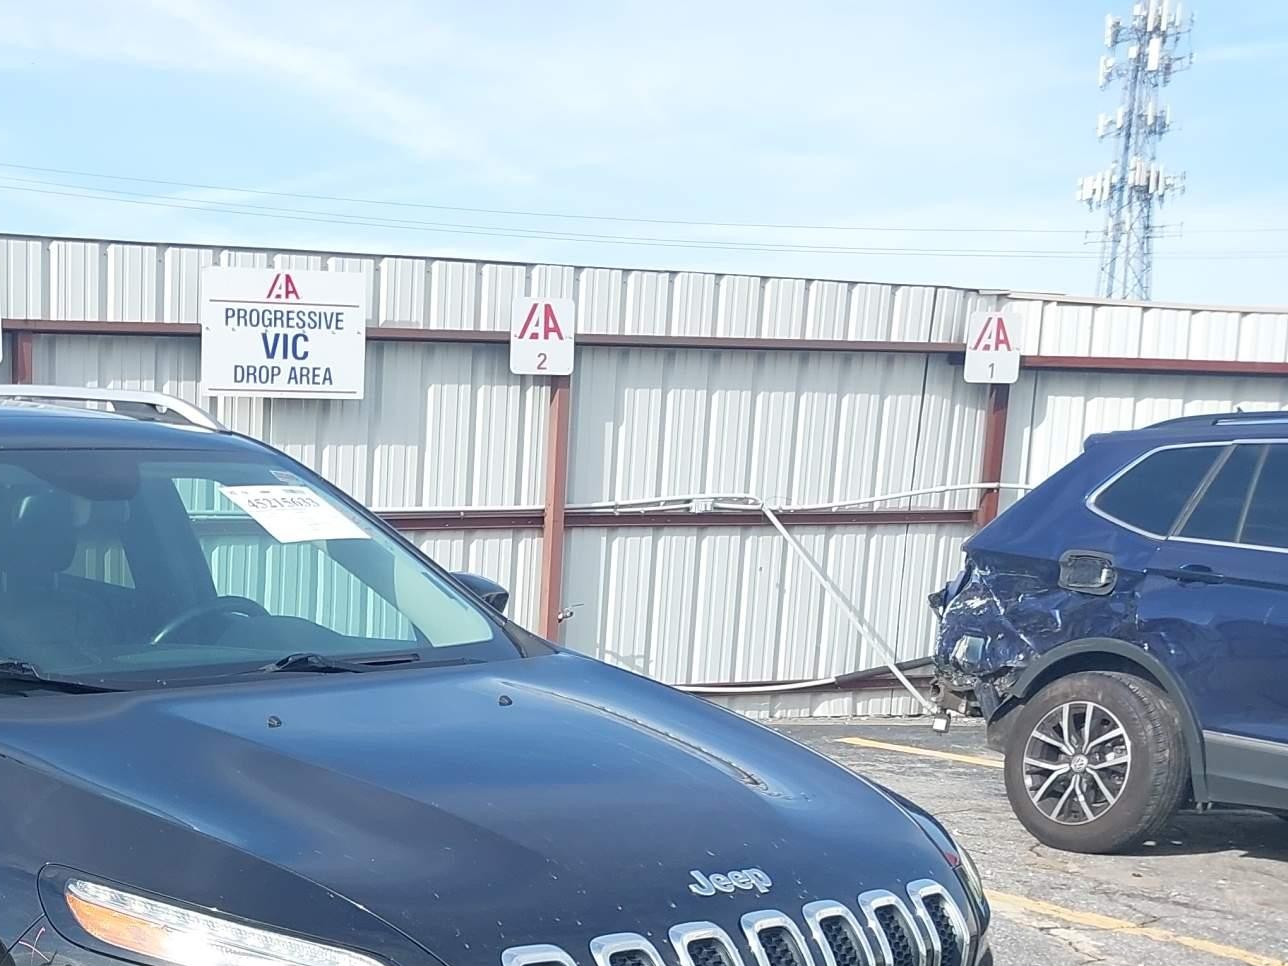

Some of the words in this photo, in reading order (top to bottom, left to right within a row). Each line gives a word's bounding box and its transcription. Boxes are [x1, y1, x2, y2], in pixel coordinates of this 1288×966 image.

[224, 307, 345, 331] PROGRESSIVE
[261, 332, 310, 361] VIC
[536, 352, 548, 370] 2
[988, 362, 995, 379] 1
[233, 364, 282, 385] DROP
[287, 365, 334, 386] AREA
[688, 868, 773, 897] Jeep
